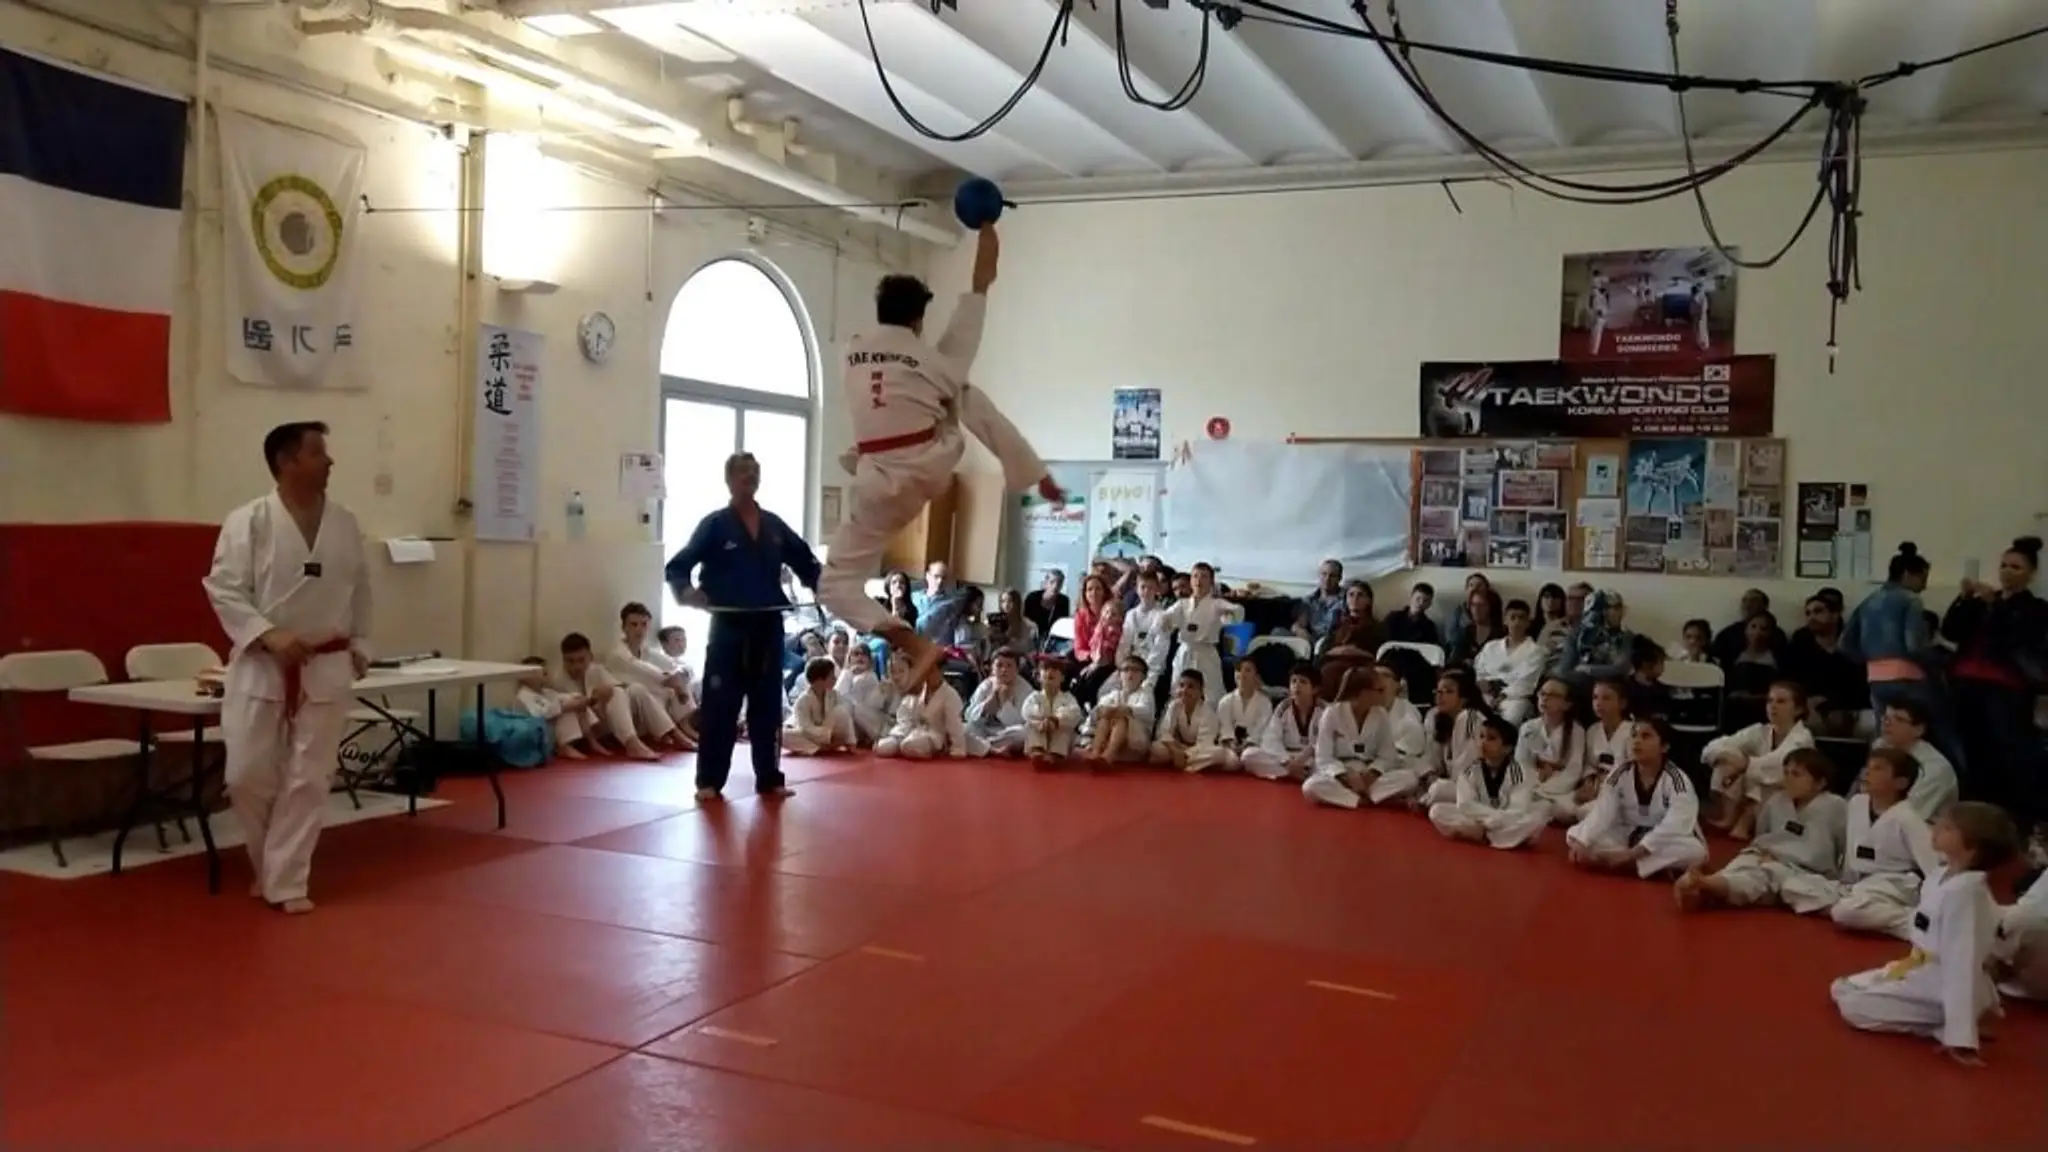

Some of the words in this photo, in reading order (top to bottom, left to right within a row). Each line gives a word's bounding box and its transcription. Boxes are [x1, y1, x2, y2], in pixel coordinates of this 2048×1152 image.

[484, 332, 513, 416] 柔道
[1487, 384, 1730, 406] TAEKWONDO
[1567, 405, 1616, 416] KOREA
[1617, 404, 1689, 415] SPORTING
[1690, 404, 1730, 414] CLUB
